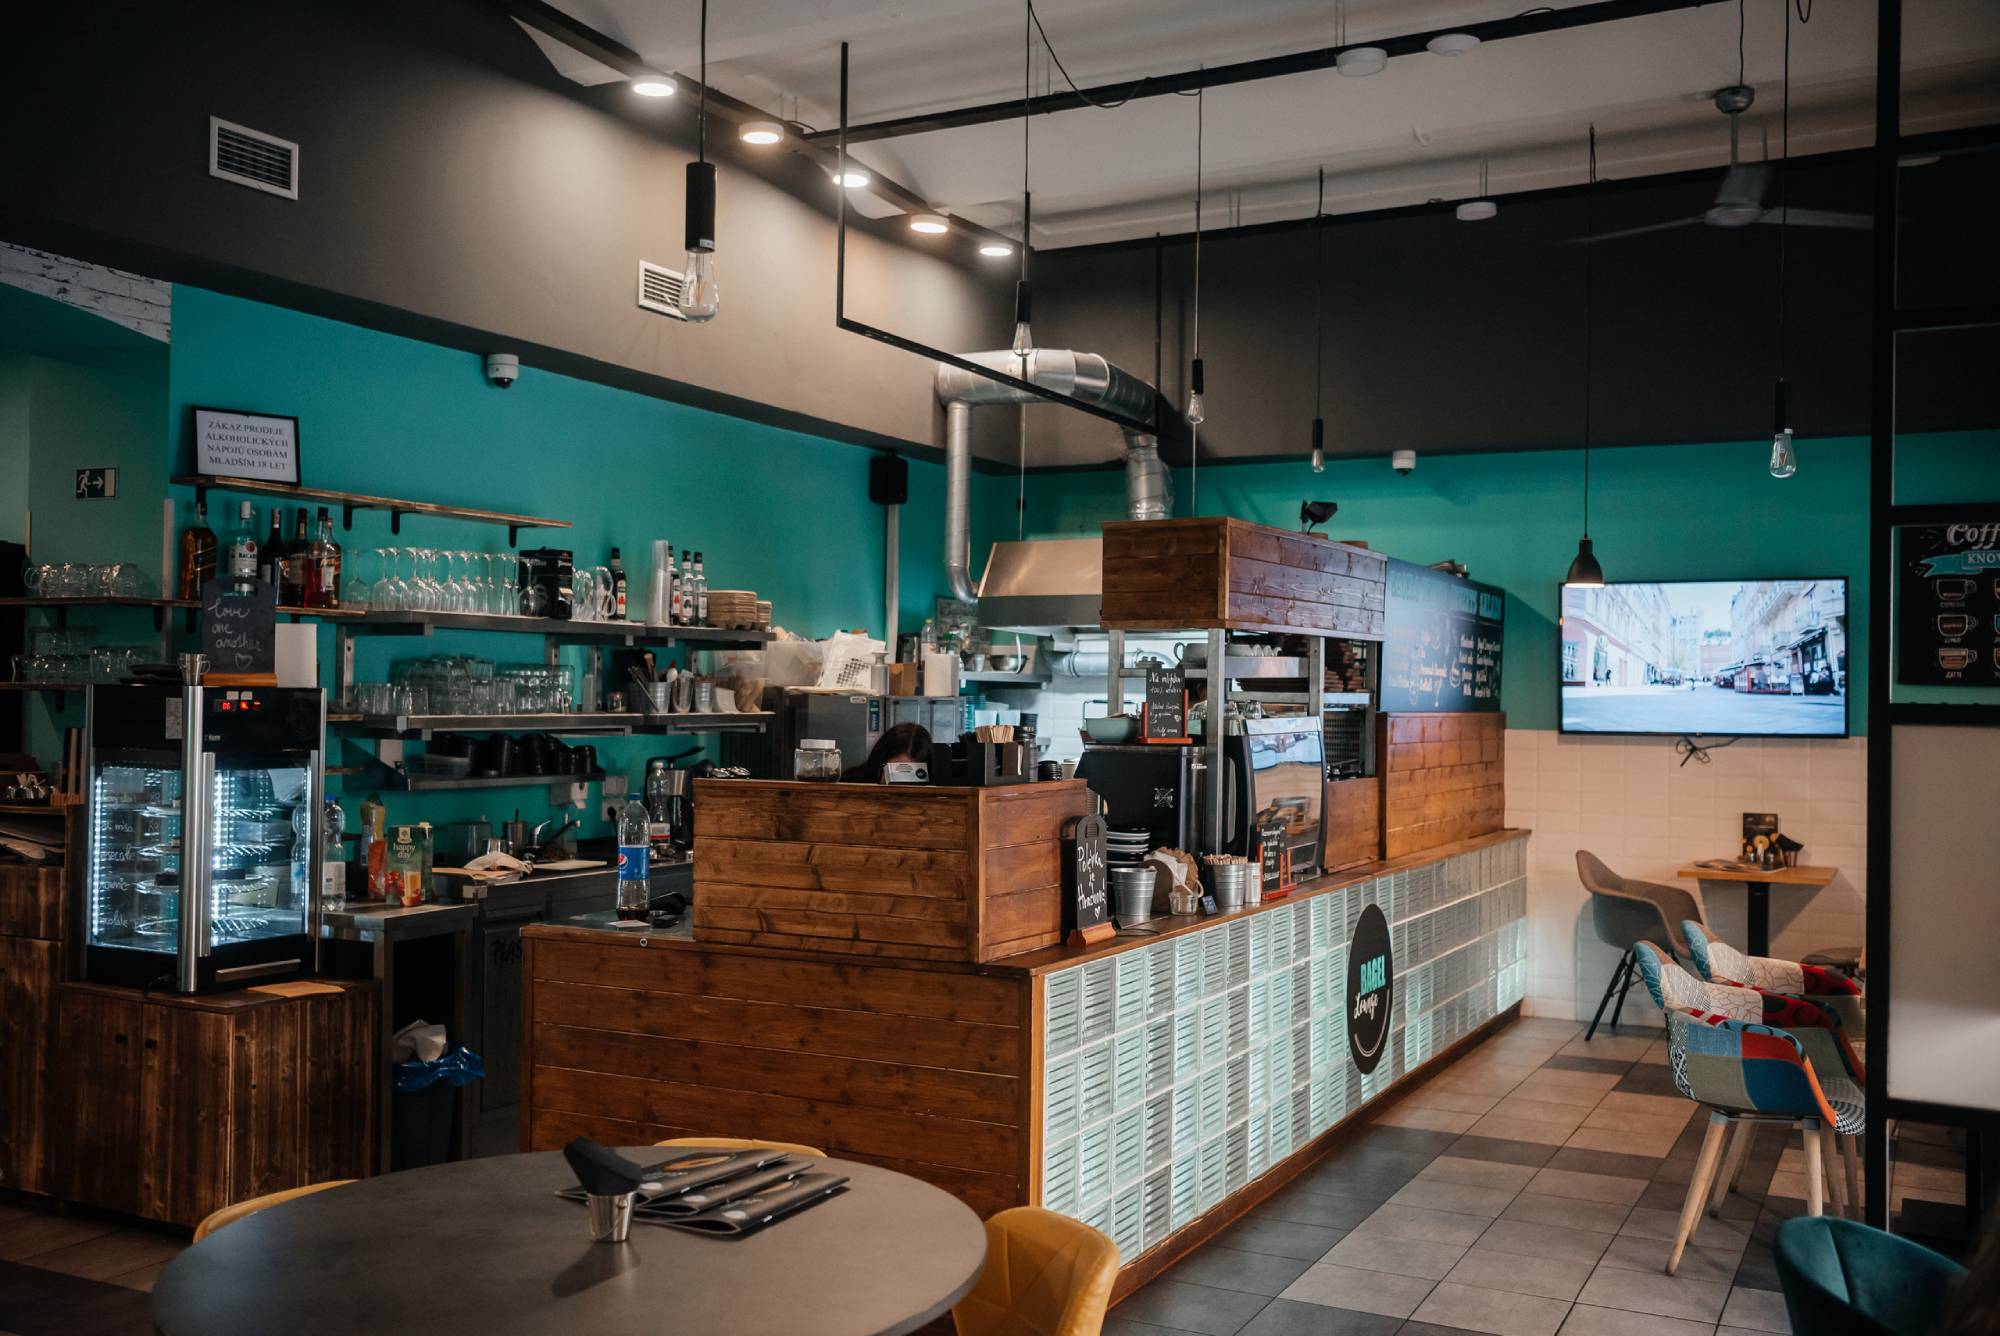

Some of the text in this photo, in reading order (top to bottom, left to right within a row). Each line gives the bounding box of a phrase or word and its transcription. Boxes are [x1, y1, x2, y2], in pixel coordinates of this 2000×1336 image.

[208, 420, 283, 436] ZÁKAZ PRODEJE
[206, 432, 289, 447] ALKOHOLICKÝCH
[209, 456, 255, 468] MLADŠÍM
[1967, 552, 2000, 564] KNO
[211, 623, 233, 634] one
[215, 632, 262, 651] another
[393, 843, 416, 855] happy
[397, 851, 410, 860] day
[1088, 872, 1095, 887] je
[1360, 955, 1386, 996] BAGEL
